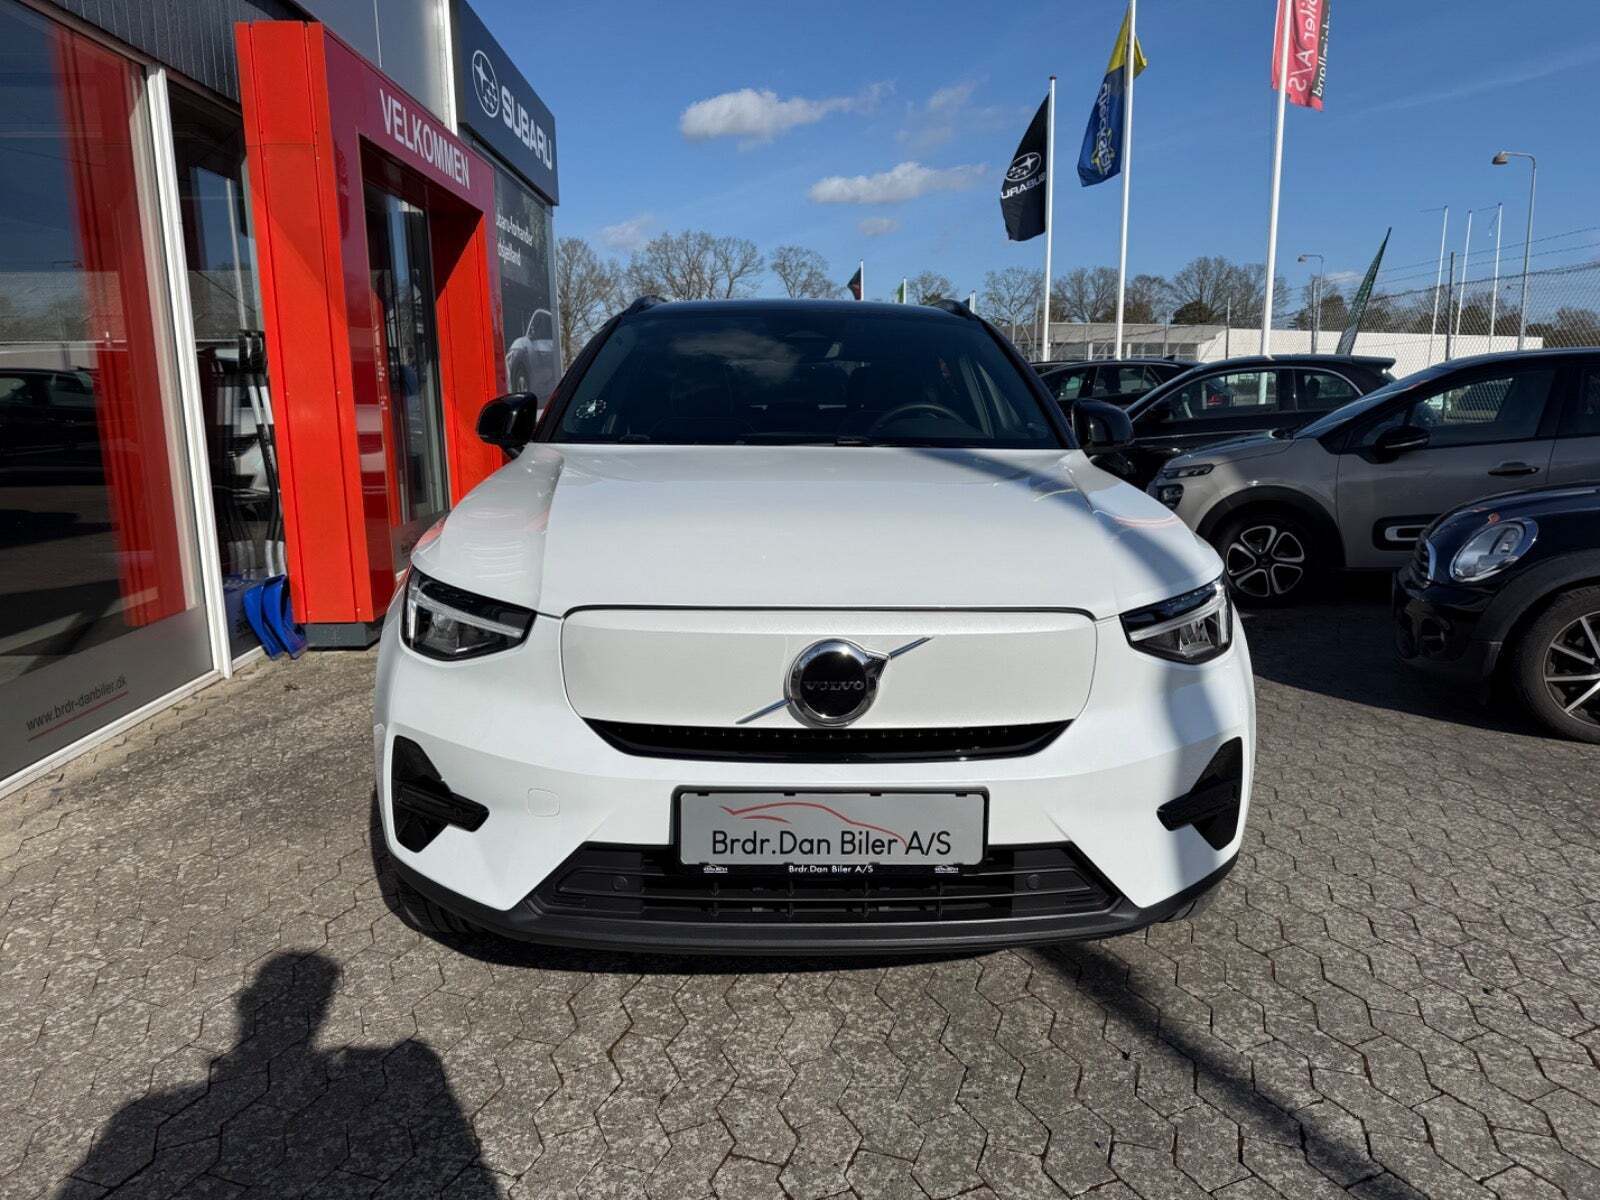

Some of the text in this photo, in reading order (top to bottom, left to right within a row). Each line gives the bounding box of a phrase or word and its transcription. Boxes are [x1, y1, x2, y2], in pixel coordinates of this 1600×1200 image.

[380, 88, 470, 190] VELKOMMEN
[501, 85, 552, 171] SUBARU
[803, 680, 865, 691] VOLVO
[712, 830, 952, 856] Brdr.Dan Biler A/S
[788, 864, 874, 874] Brdr.Dan Biler A/S
